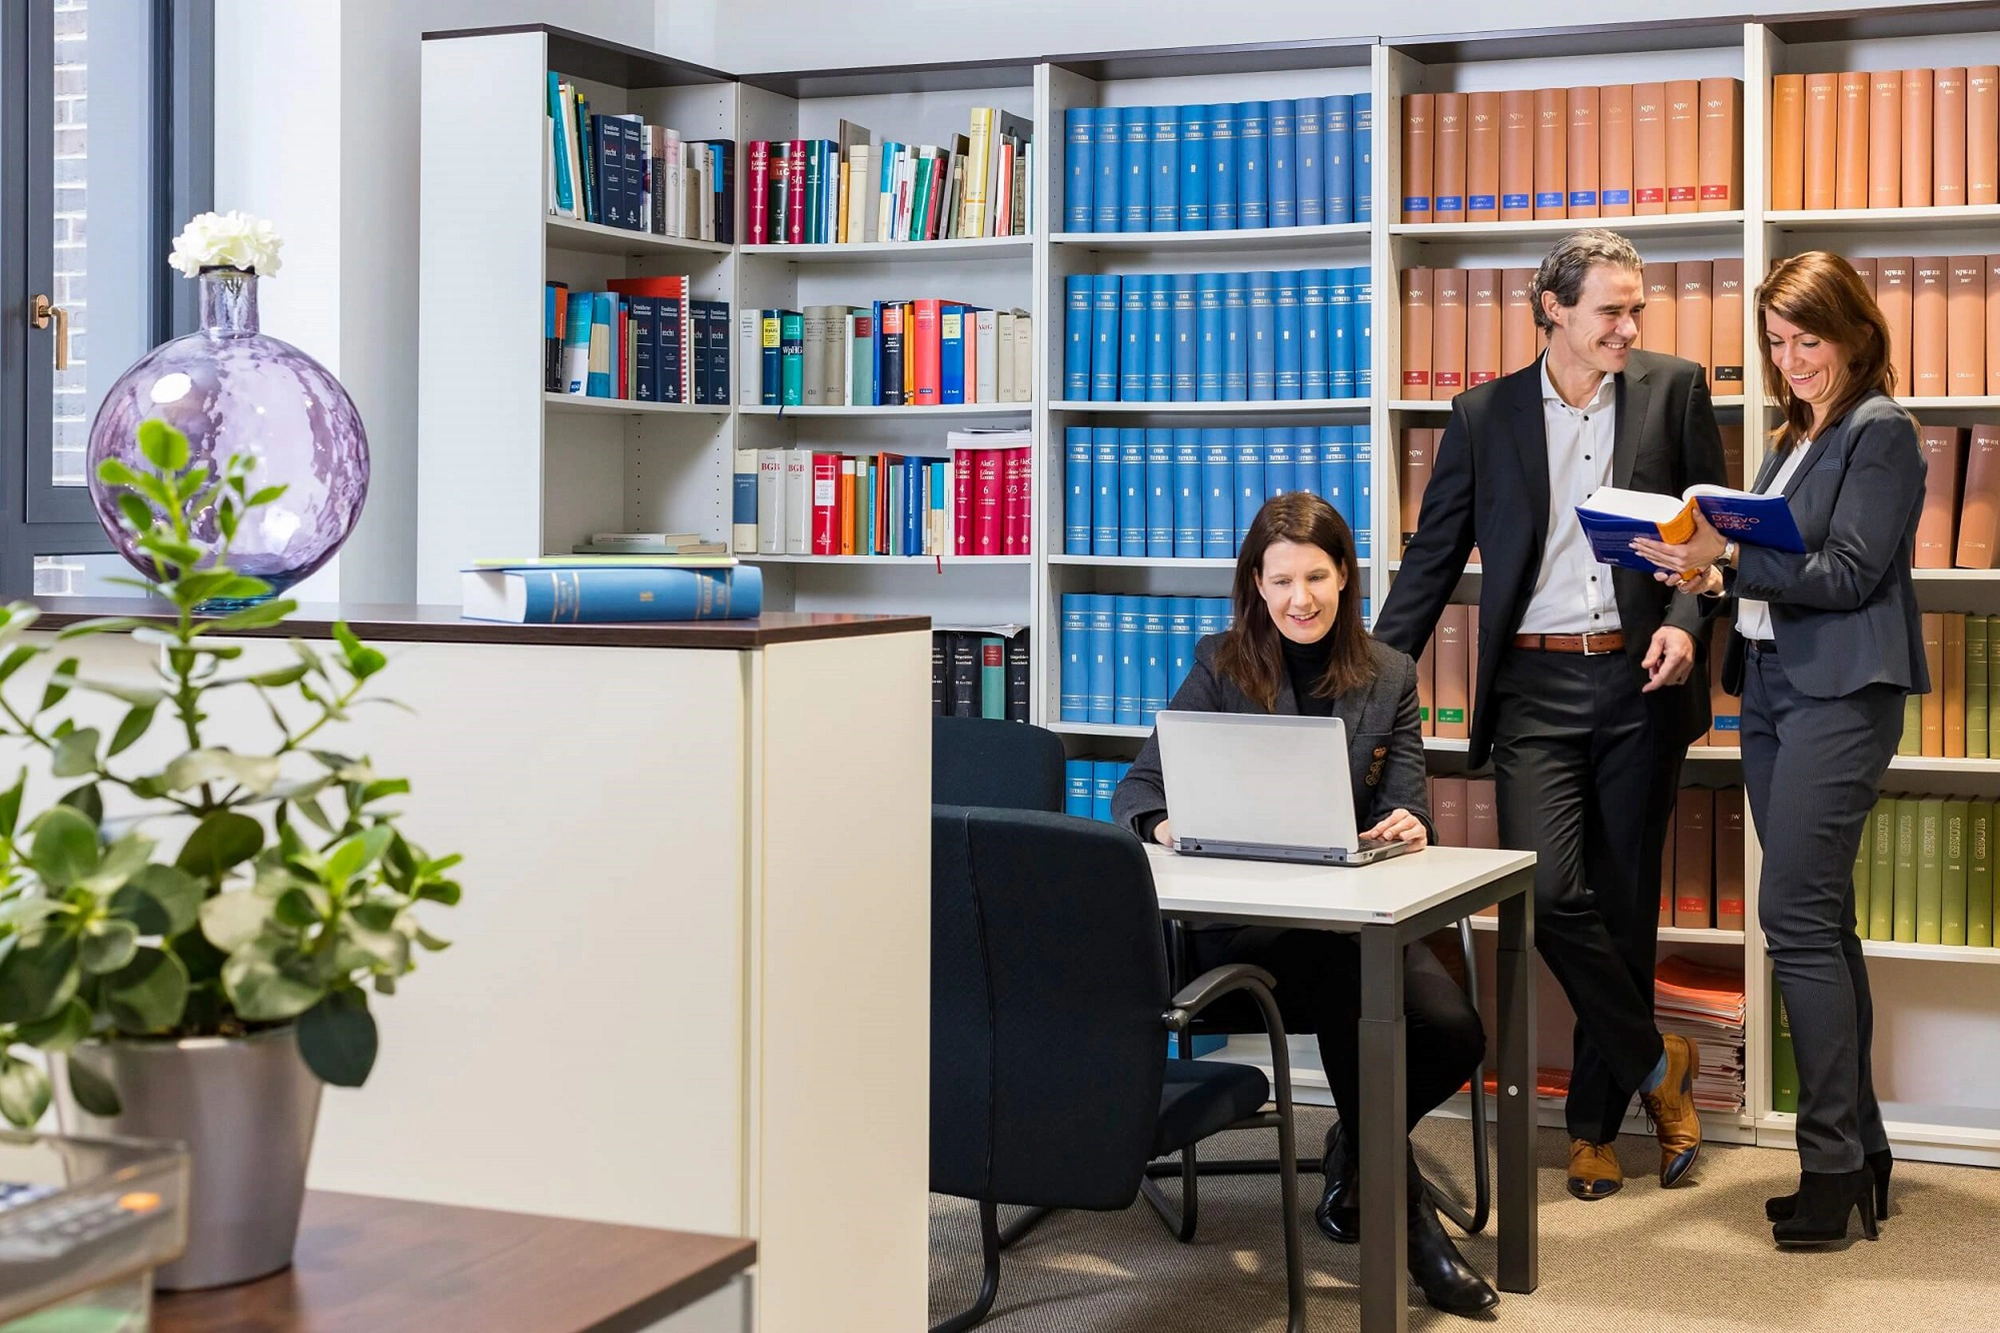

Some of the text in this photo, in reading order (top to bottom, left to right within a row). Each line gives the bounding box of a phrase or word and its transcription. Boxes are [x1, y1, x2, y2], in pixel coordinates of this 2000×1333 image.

[1708, 100, 1722, 108] NJW
[1543, 111, 1558, 120] NJW
[1442, 116, 1457, 124] NJW
[1685, 282, 1700, 290] NJW
[1409, 290, 1423, 298] NJW
[1477, 290, 1492, 298] NJW
[1409, 449, 1423, 457] NJW
[762, 462, 780, 471] BGB
[788, 464, 805, 472] BGB
[960, 484, 964, 493] 4
[984, 486, 988, 494] 6
[1023, 483, 1028, 491] 2
[1712, 514, 1760, 524] DSGVO
[1716, 522, 1752, 530] BDSG
